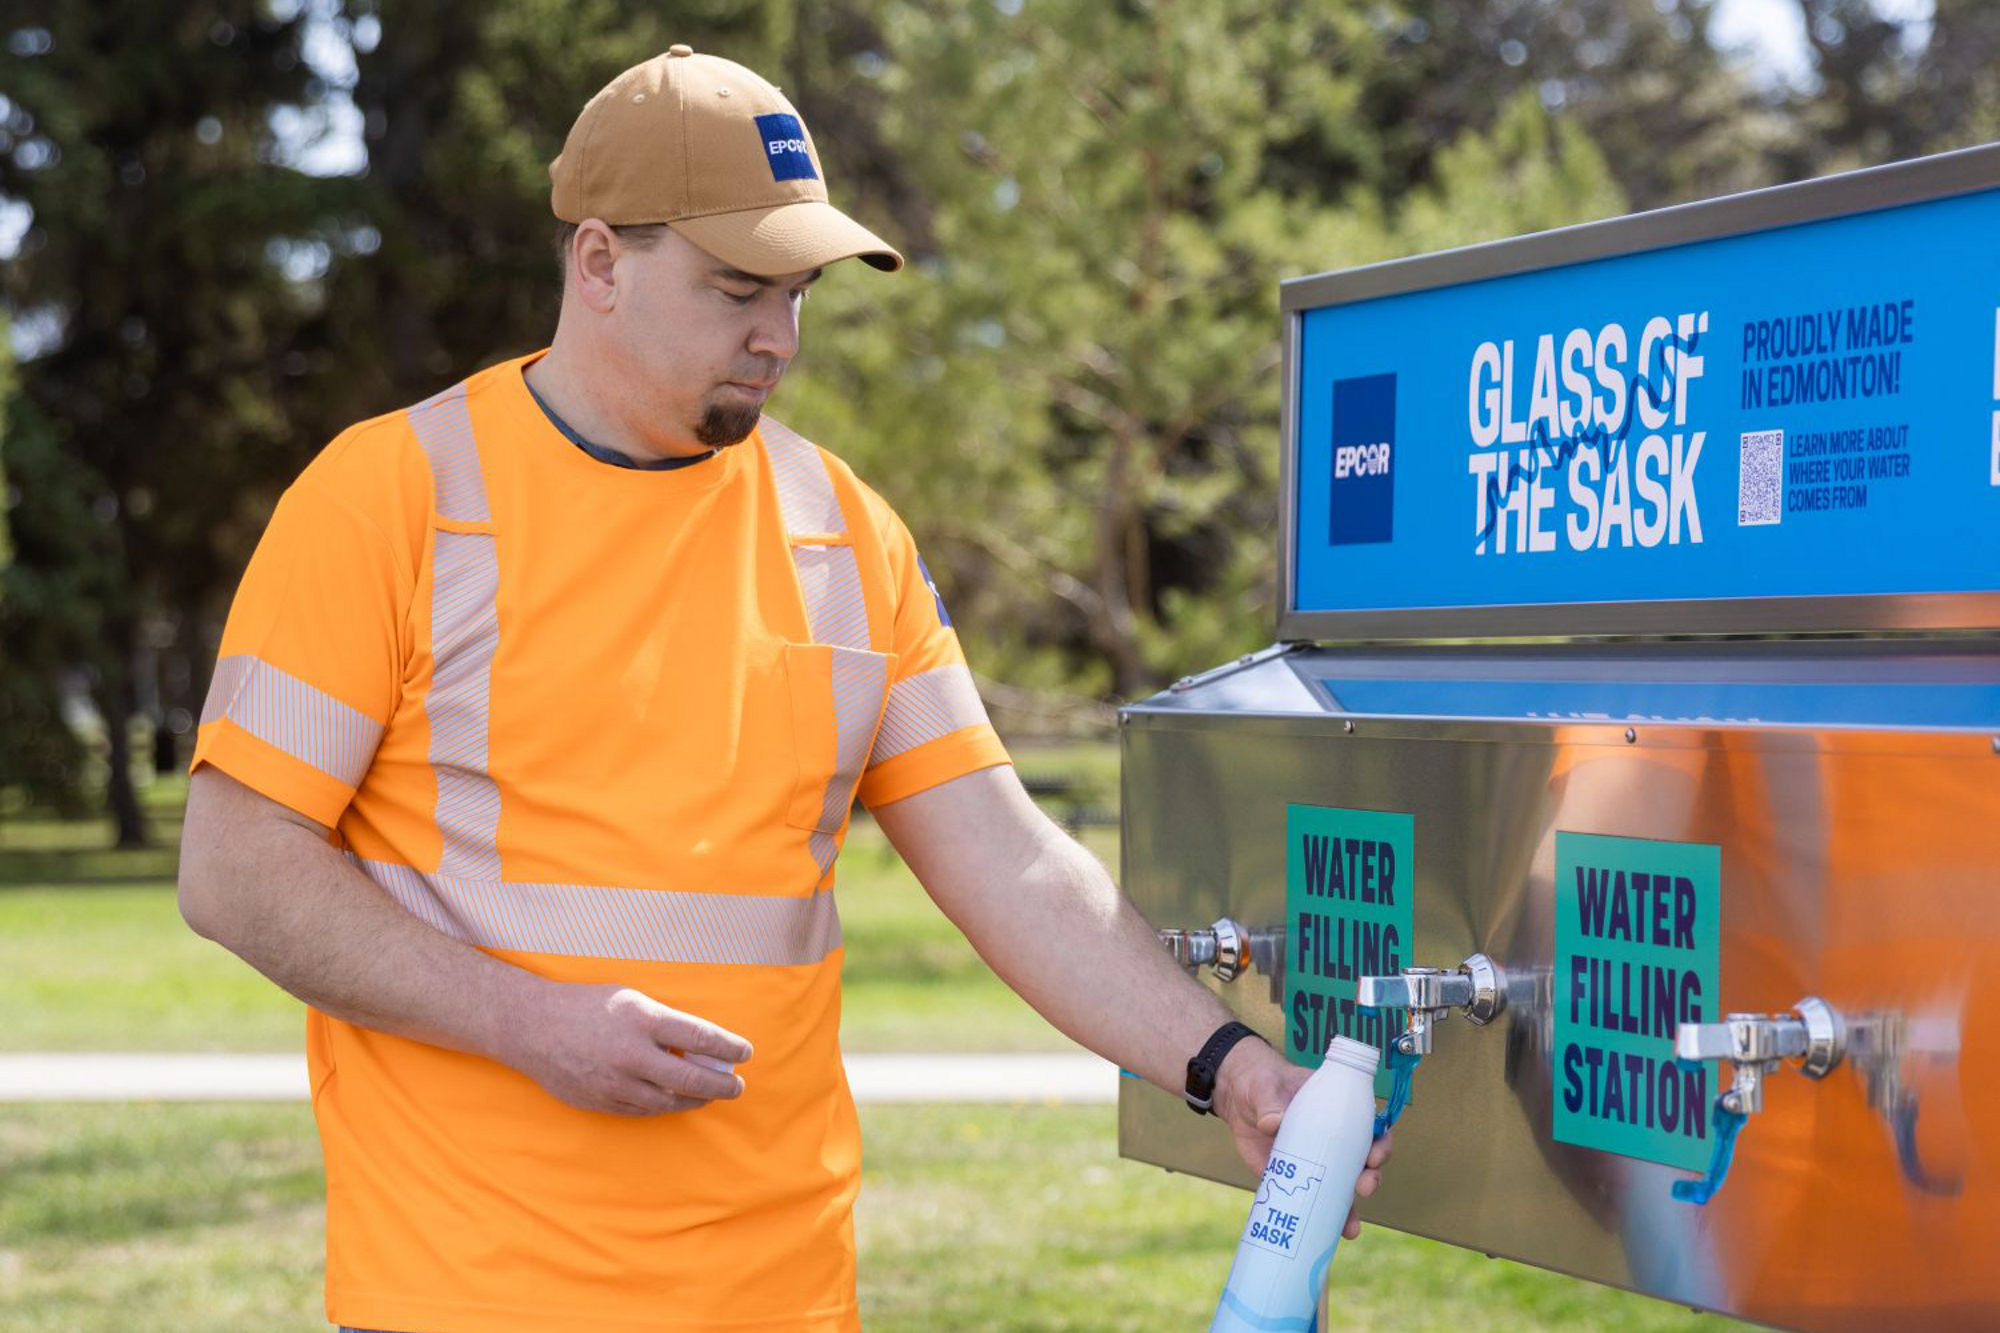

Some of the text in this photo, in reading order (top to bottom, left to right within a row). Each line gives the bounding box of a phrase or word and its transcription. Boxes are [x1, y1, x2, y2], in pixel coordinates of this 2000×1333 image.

[1743, 300, 1914, 363] PROUDLY MADE
[1469, 311, 1709, 447] GLASS OF
[1741, 351, 1901, 410] IN EDMONTON!
[1335, 443, 1390, 478] EPCOR
[1789, 425, 1909, 458] LEARN MORE ABOUT
[1789, 453, 1910, 485] WHERE YOUR WATER
[1469, 431, 1707, 555] THE SASK
[1788, 484, 1867, 512] COMES FROM
[1303, 834, 1395, 906] WATER
[1576, 866, 1696, 950] WATER
[1298, 912, 1399, 982] FILLING
[1570, 954, 1702, 1040] FILLING
[1563, 1042, 1706, 1140] STATION
[1265, 1157, 1296, 1179] ASS
[1250, 1221, 1293, 1249] SASK
[1267, 1207, 1299, 1232] THE
